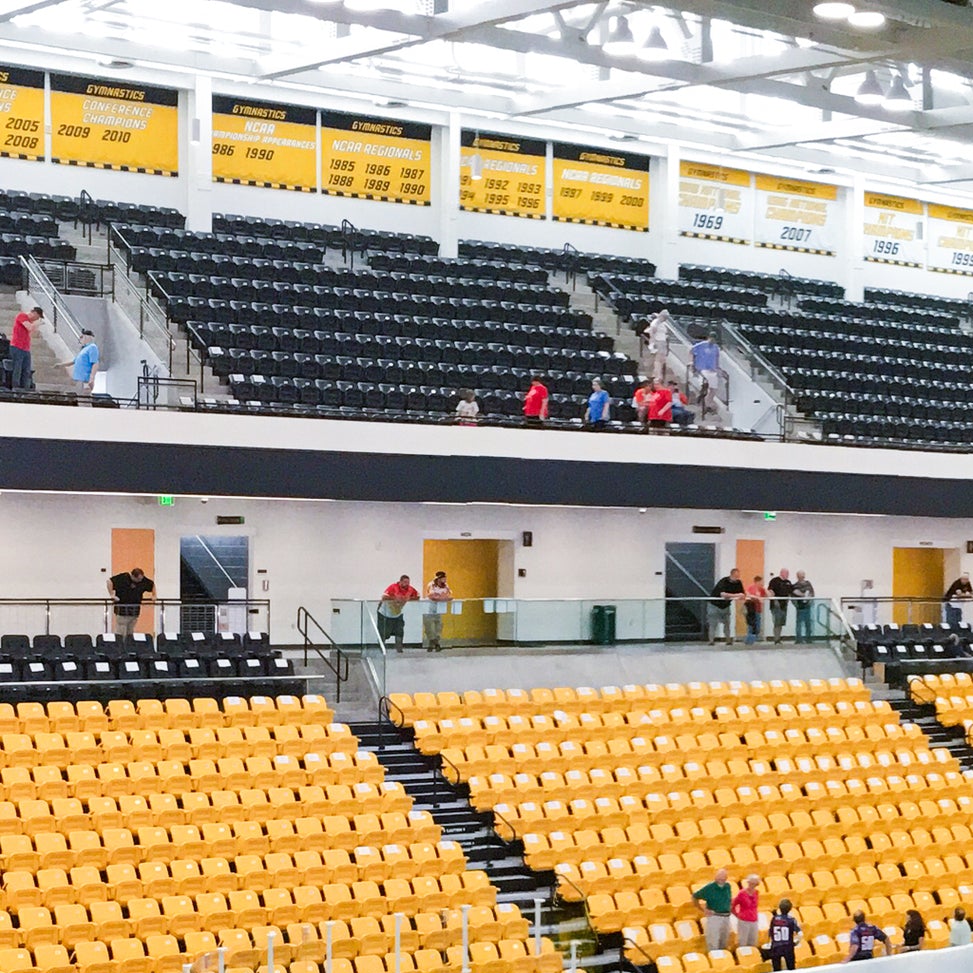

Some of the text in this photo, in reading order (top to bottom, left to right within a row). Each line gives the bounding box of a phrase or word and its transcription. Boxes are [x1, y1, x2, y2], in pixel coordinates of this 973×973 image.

[86, 84, 145, 100] GYMNASTICS
[82, 99, 153, 118] CONFERENCE
[232, 104, 287, 120] GYMNASTICS
[5, 117, 40, 132] 2005
[82, 112, 147, 130] CHAMPIONS
[244, 121, 276, 134] NCAA
[351, 120, 404, 135] GYMNASTICS
[4, 134, 39, 149] 2008
[57, 124, 131, 143] 2009 2010
[261, 136, 316, 149] APPEARANCES
[331, 139, 423, 161] NCAA REGIONALS
[212, 143, 275, 161] 986 1990
[329, 159, 425, 180] 1985 1986 1987
[483, 159, 538, 175] REGIONALS
[328, 174, 426, 196] 1988 1989 1990
[484, 178, 510, 190] 1992
[517, 182, 542, 194] 1993
[484, 192, 510, 205] 1995
[517, 196, 541, 208] 1996
[559, 187, 645, 208] 1997 1999 2000
[692, 213, 724, 230] 1969
[780, 226, 813, 242] 2007
[873, 239, 900, 256] 1996
[773, 926, 789, 942] 50
